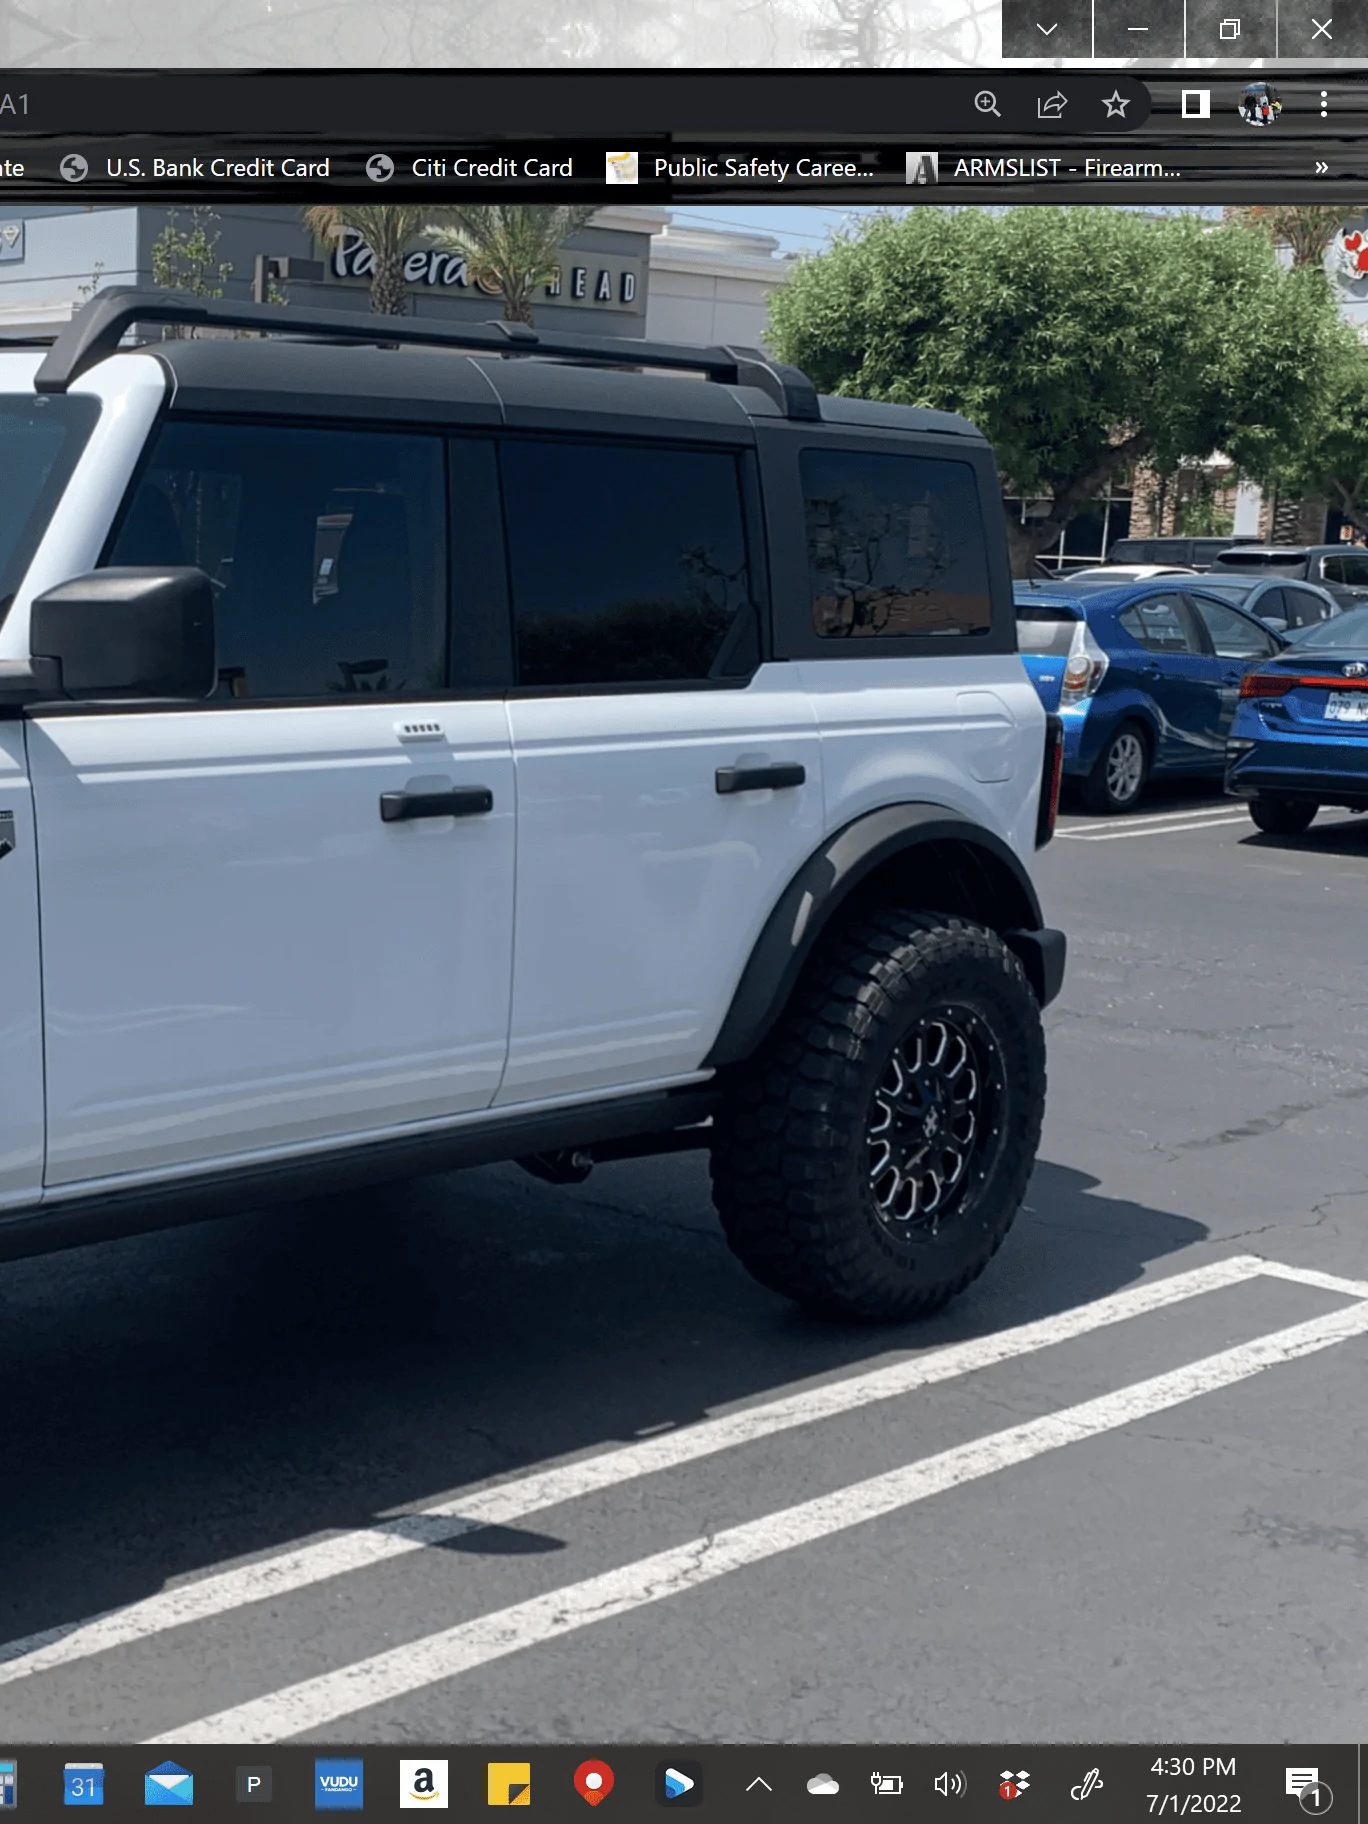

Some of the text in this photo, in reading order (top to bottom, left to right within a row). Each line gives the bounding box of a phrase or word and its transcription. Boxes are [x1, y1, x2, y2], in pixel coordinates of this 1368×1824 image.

[107, 157, 329, 177] U.S. Bank Credit Card
[412, 157, 572, 177] Citi Credit Card
[655, 157, 874, 183] Public Safety Caree...
[953, 158, 1062, 177] ARMSLIST
[1085, 158, 1181, 177] Firearm...
[325, 222, 472, 287] Paera
[1150, 1757, 1236, 1776] 4:30 PM
[71, 1777, 94, 1797] 31
[247, 1776, 261, 1793] P
[319, 1776, 358, 1788] VUDU
[1146, 1794, 1242, 1816] 7/1/2022
